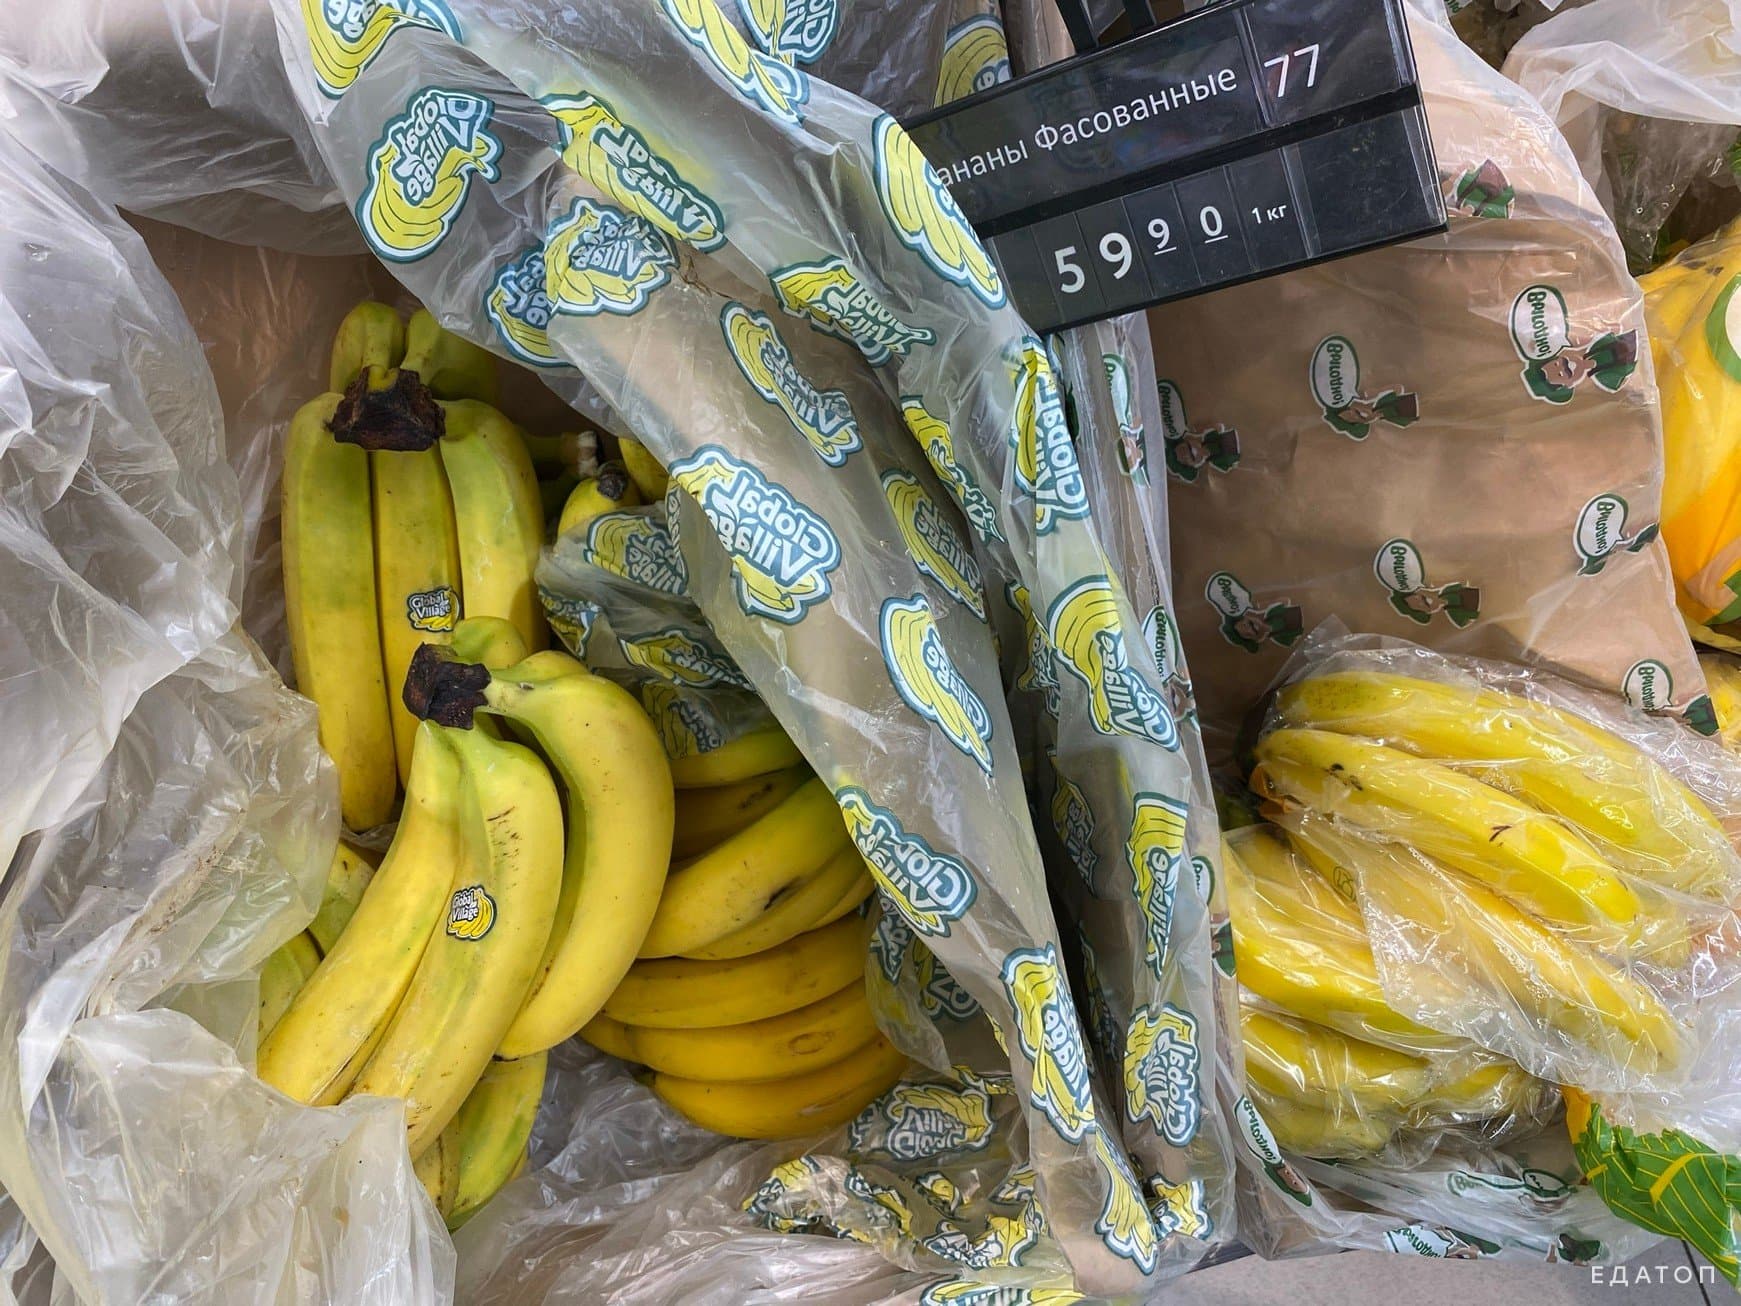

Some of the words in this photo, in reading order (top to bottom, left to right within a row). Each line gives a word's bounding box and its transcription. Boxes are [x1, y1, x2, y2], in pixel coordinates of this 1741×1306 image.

[1264, 44, 1319, 97] 77
[938, 139, 1029, 187] ананы
[1034, 68, 1237, 151] Фасованные
[1251, 207, 1261, 224] 1
[1267, 205, 1287, 221] кг
[412, 592, 446, 607] Global
